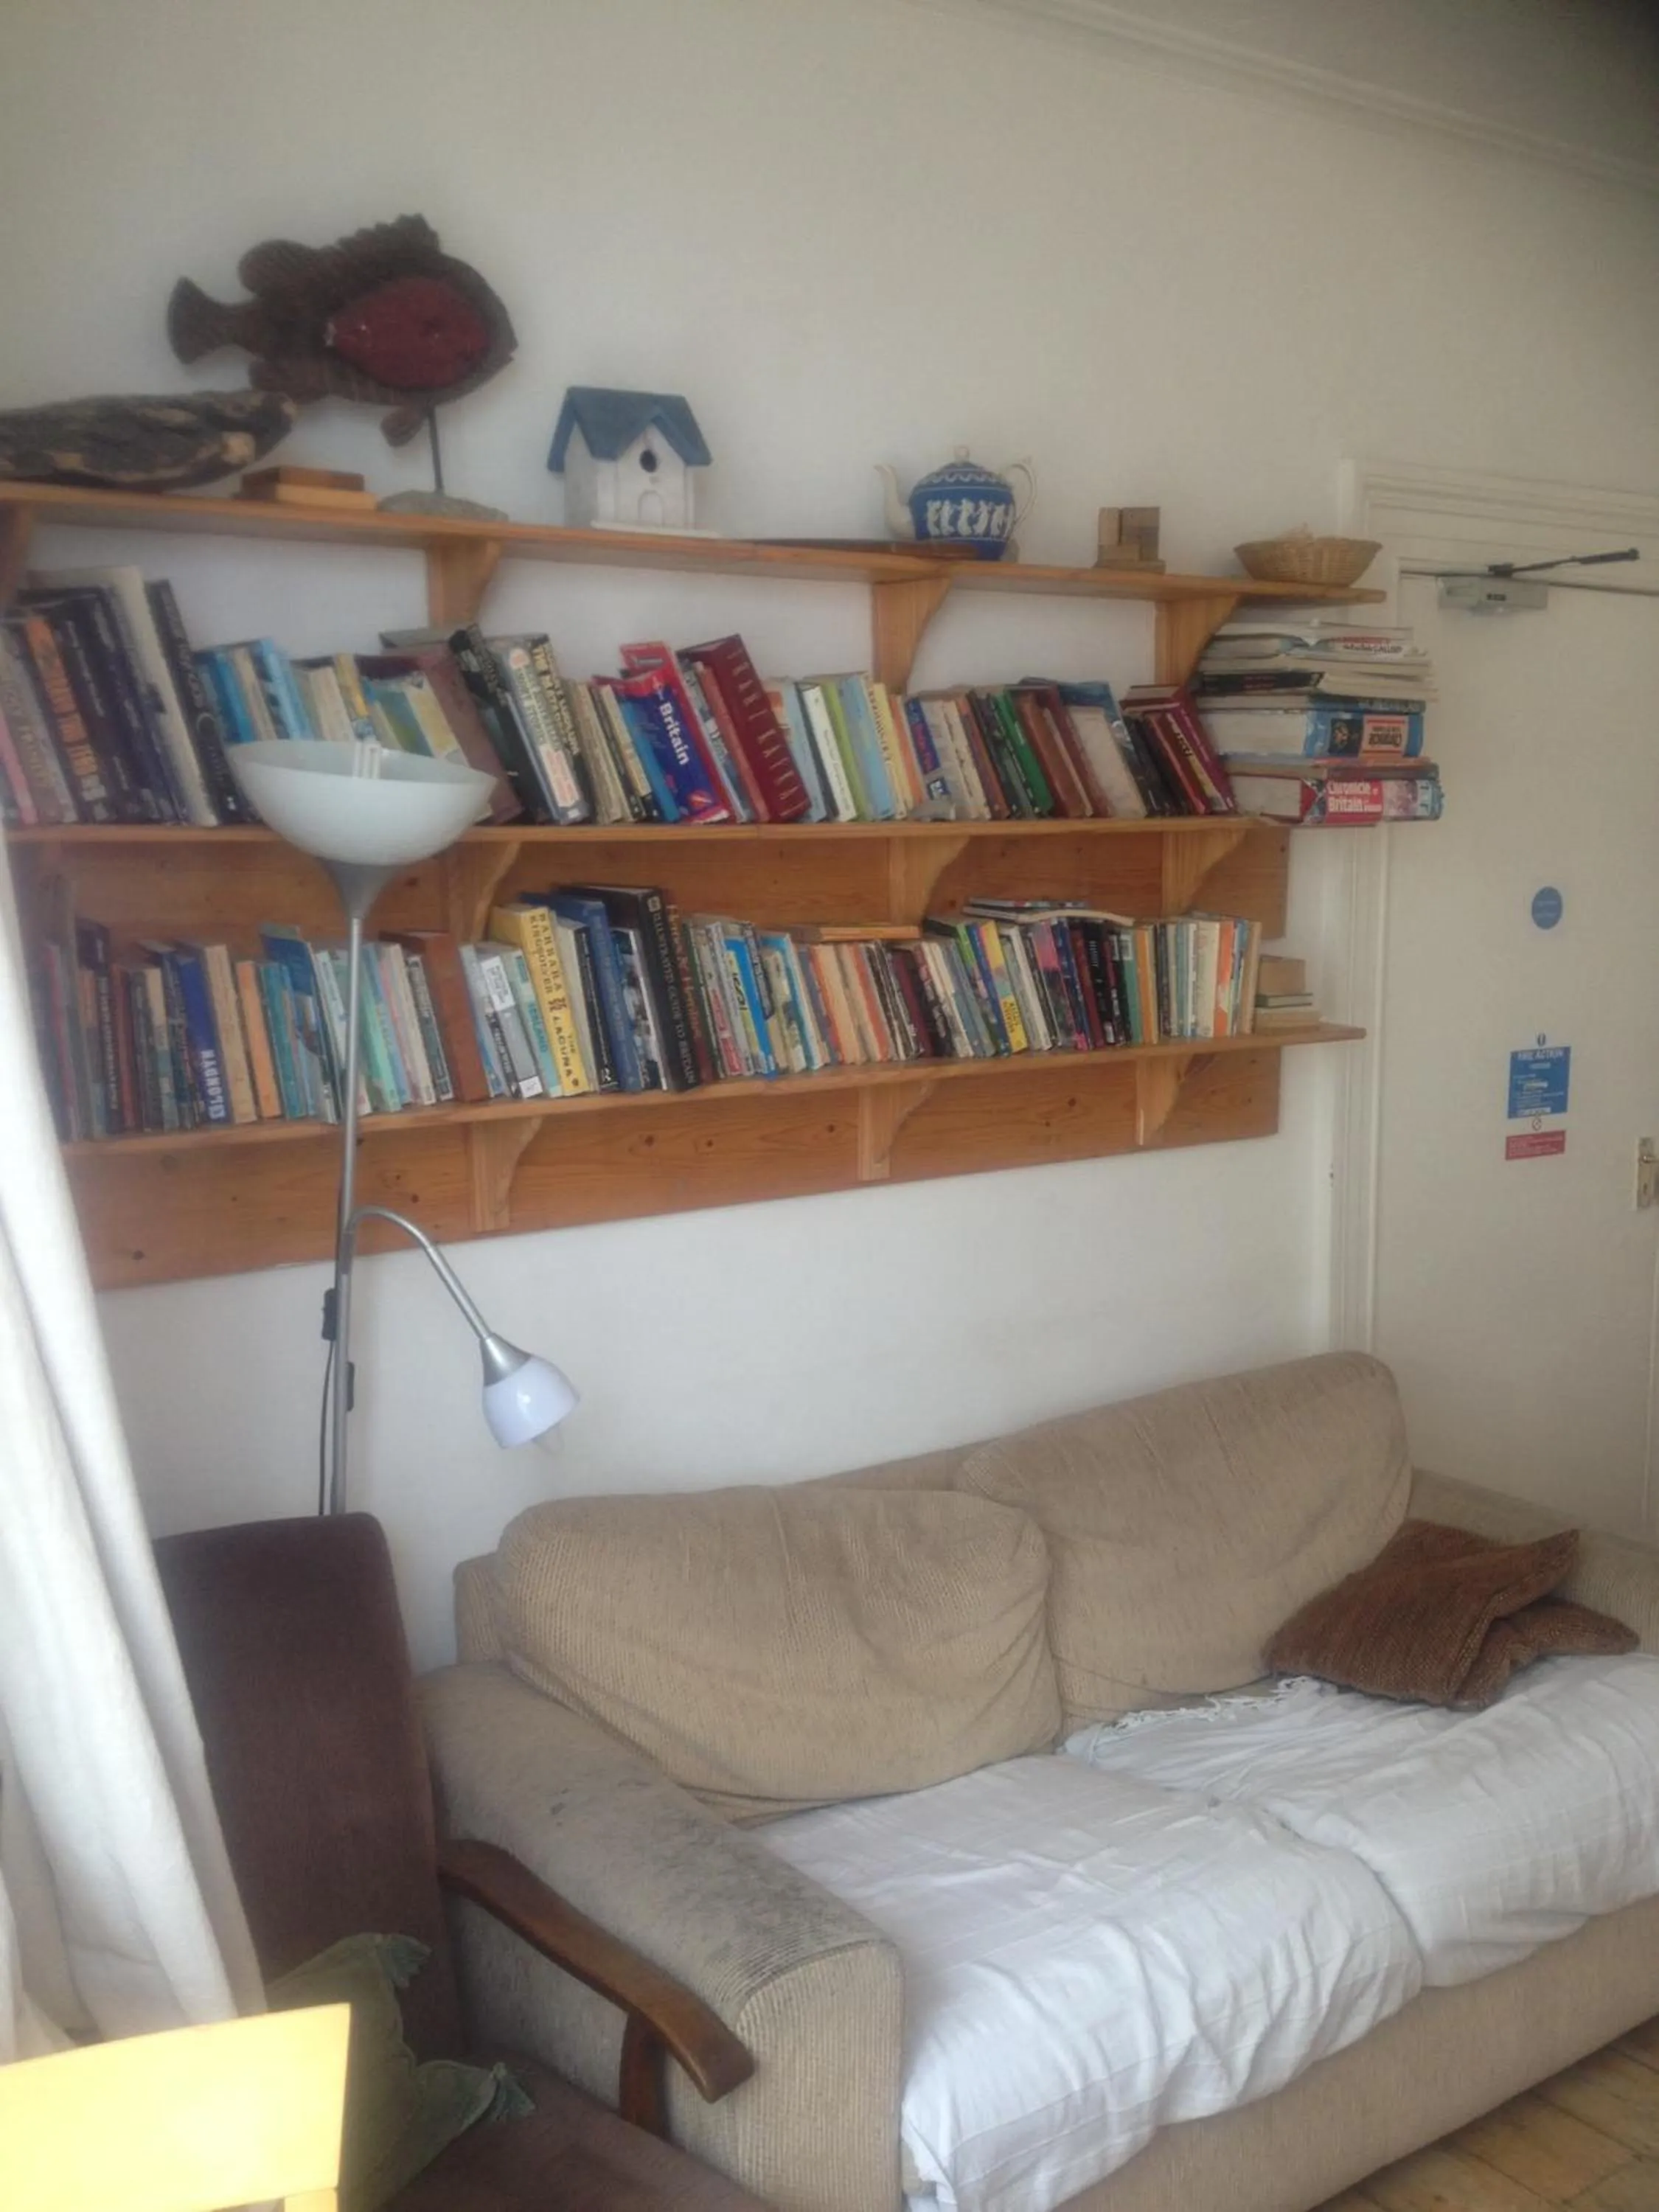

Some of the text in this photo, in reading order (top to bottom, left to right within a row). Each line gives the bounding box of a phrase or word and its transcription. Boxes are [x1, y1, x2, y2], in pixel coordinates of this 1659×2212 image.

[659, 702, 690, 765] Britain
[529, 915, 553, 995] KINGSOLVER
[539, 913, 563, 992] BARBARA
[552, 1016, 573, 1077] LACUNA
[675, 1023, 686, 1038] TO
[678, 1037, 696, 1085] BRITAIN
[201, 1049, 224, 1105] LONDYN
